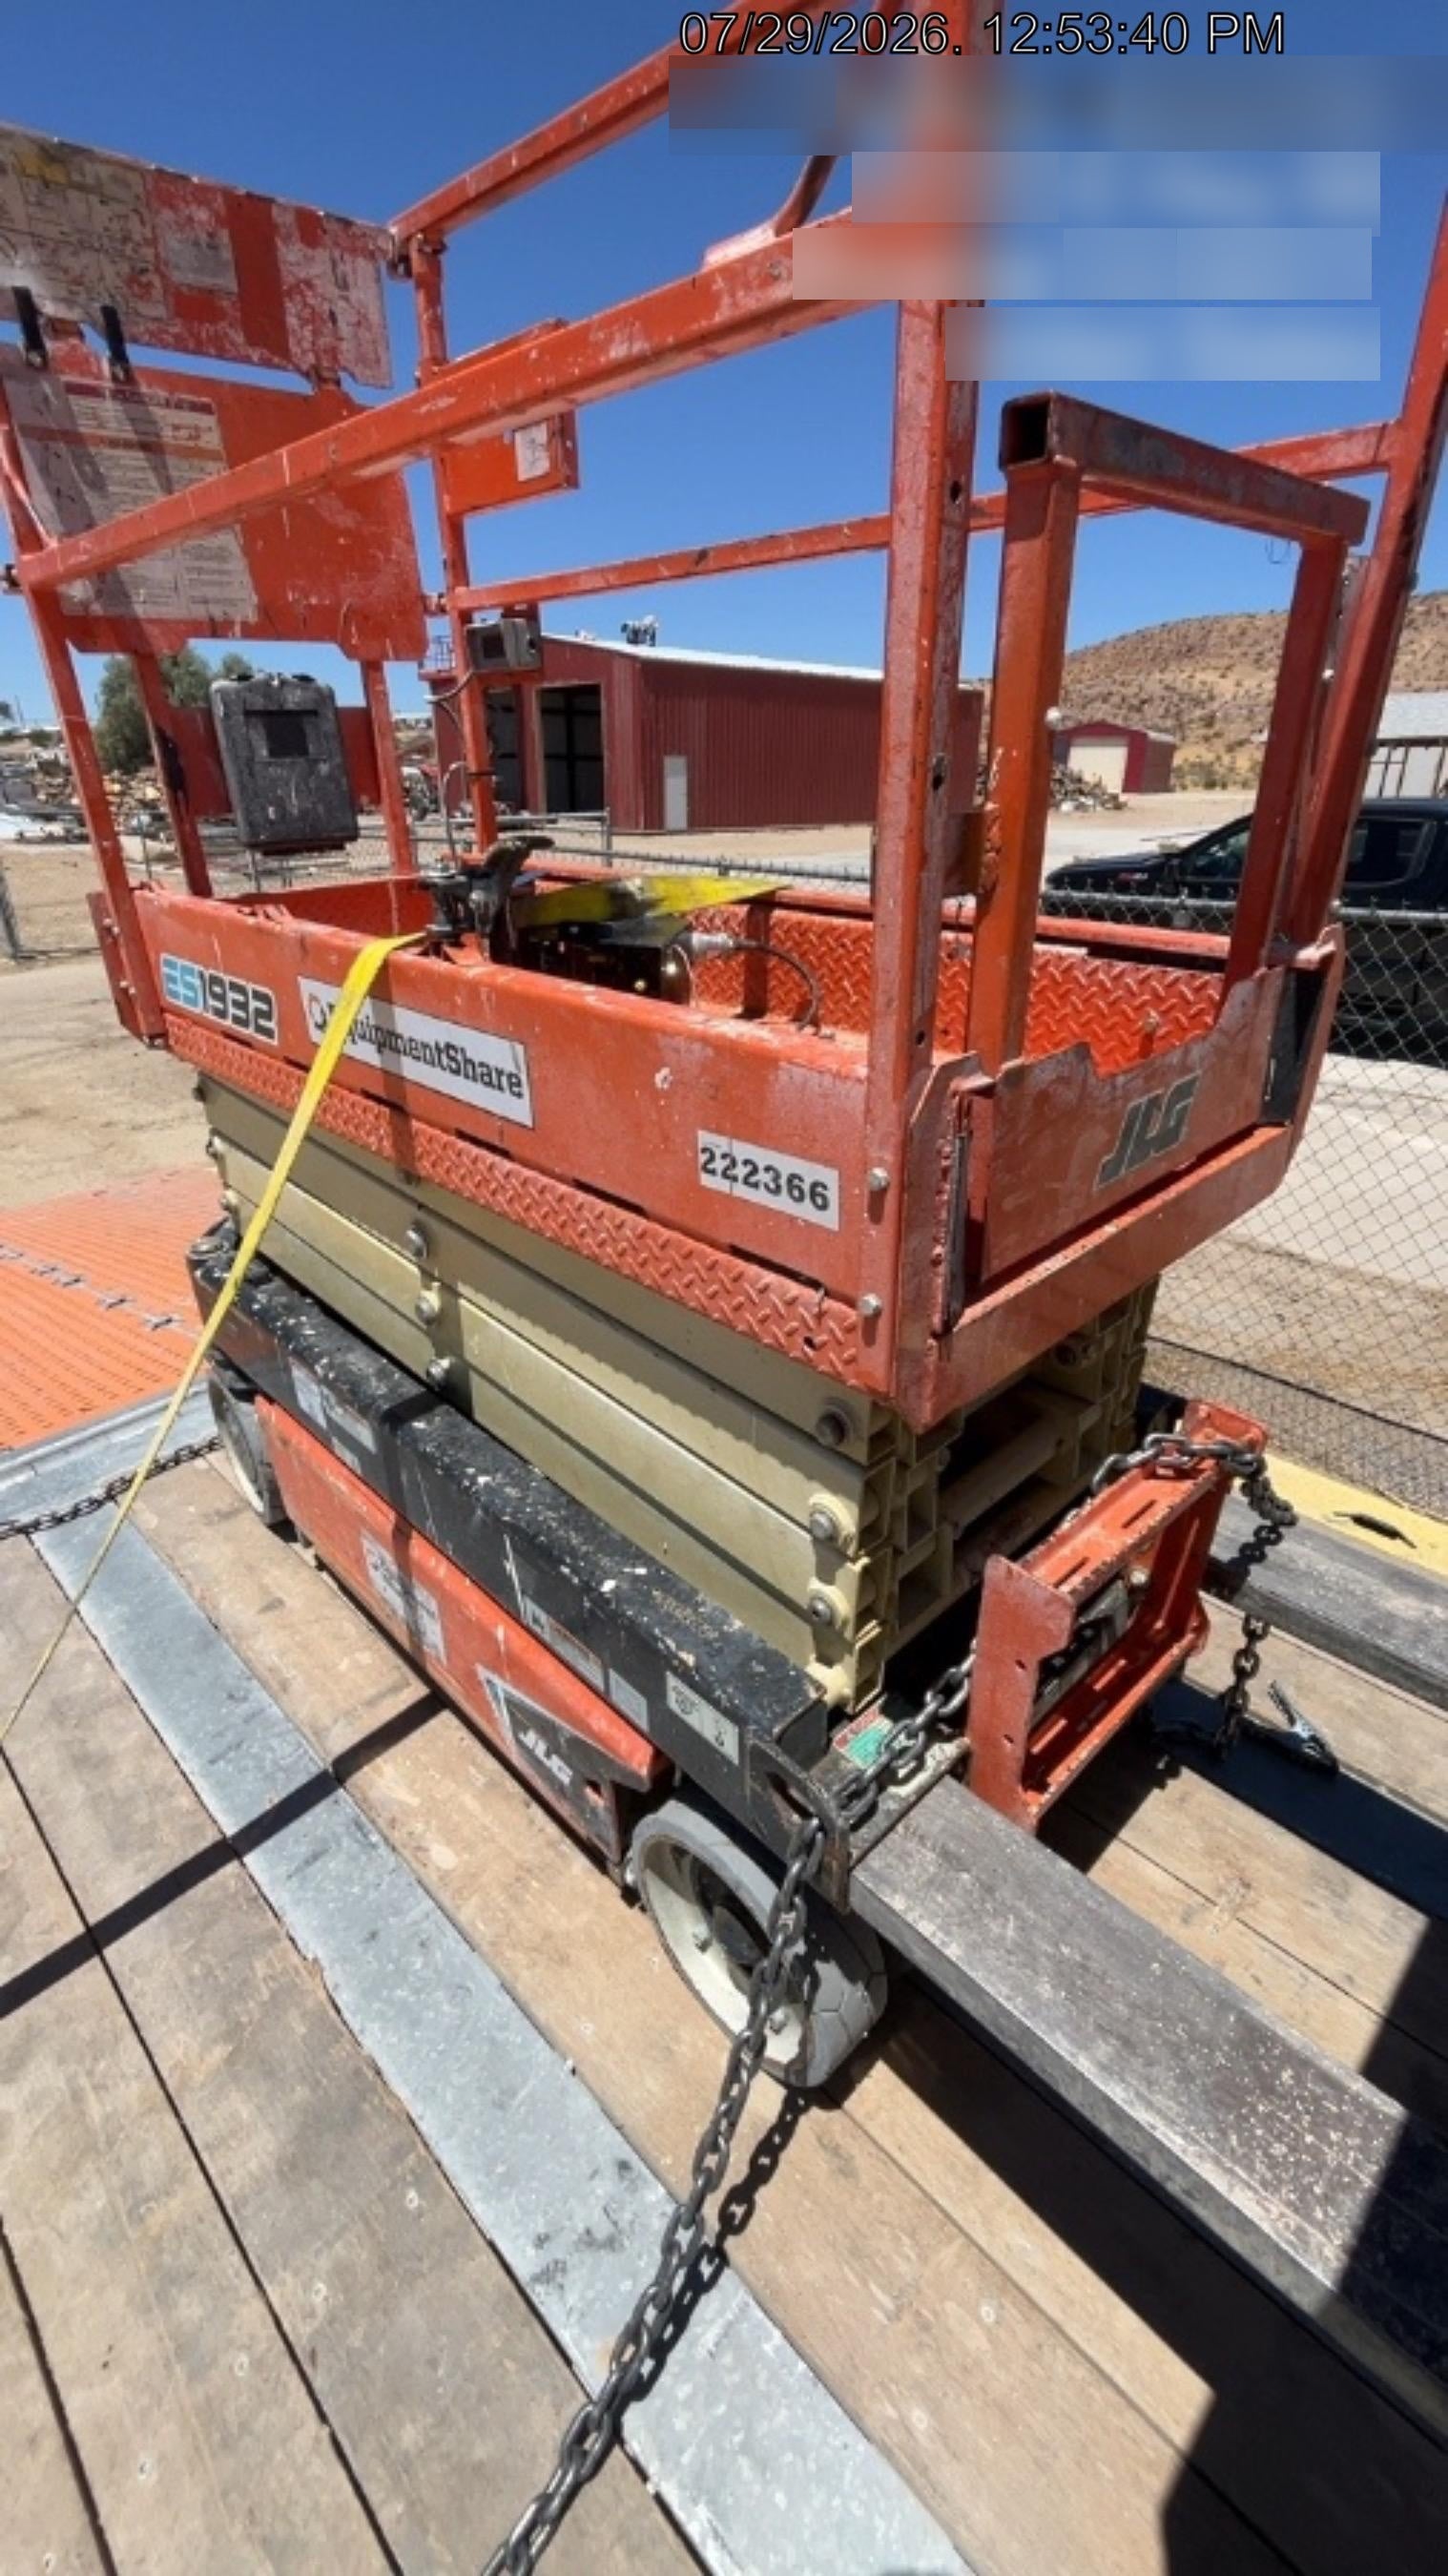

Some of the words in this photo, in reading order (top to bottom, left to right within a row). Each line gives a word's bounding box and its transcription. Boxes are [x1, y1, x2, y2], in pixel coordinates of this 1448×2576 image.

[161, 956, 276, 1042] ES1932
[1095, 1071, 1200, 1189] JLG
[700, 1147, 830, 1212] 222366
